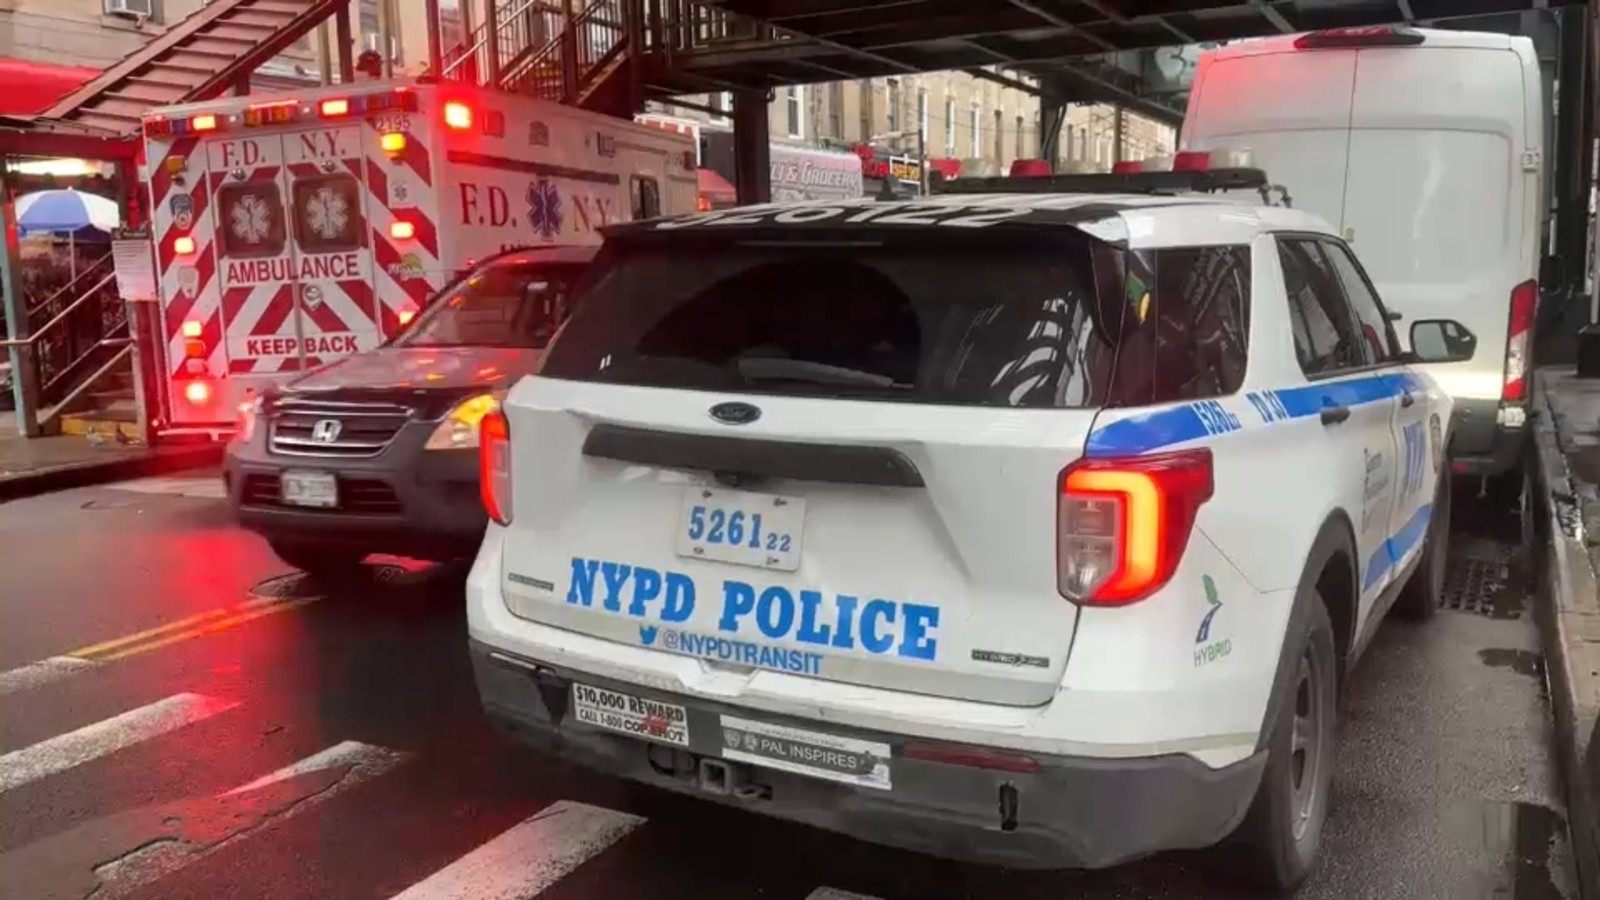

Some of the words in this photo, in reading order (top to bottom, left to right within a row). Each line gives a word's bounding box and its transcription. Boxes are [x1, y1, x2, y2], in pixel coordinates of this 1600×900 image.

[787, 165, 798, 182] &
[459, 182, 518, 228] F.D.
[227, 254, 361, 284] AMBULANCE
[247, 337, 298, 356] KEEP
[304, 335, 359, 353] BACK
[688, 505, 762, 549] 5261
[765, 532, 792, 552] 22
[566, 556, 696, 623] NYPD
[718, 579, 940, 662] POLICE
[661, 629, 824, 676] @NYPDTRANSIT
[1193, 638, 1232, 668] HYBRID
[576, 684, 625, 711] $10,000
[628, 697, 684, 722] REWARD
[579, 708, 599, 723] CALL
[623, 719, 647, 734] COP
[761, 738, 787, 756] PAL
[789, 743, 858, 770] INSPIRES
